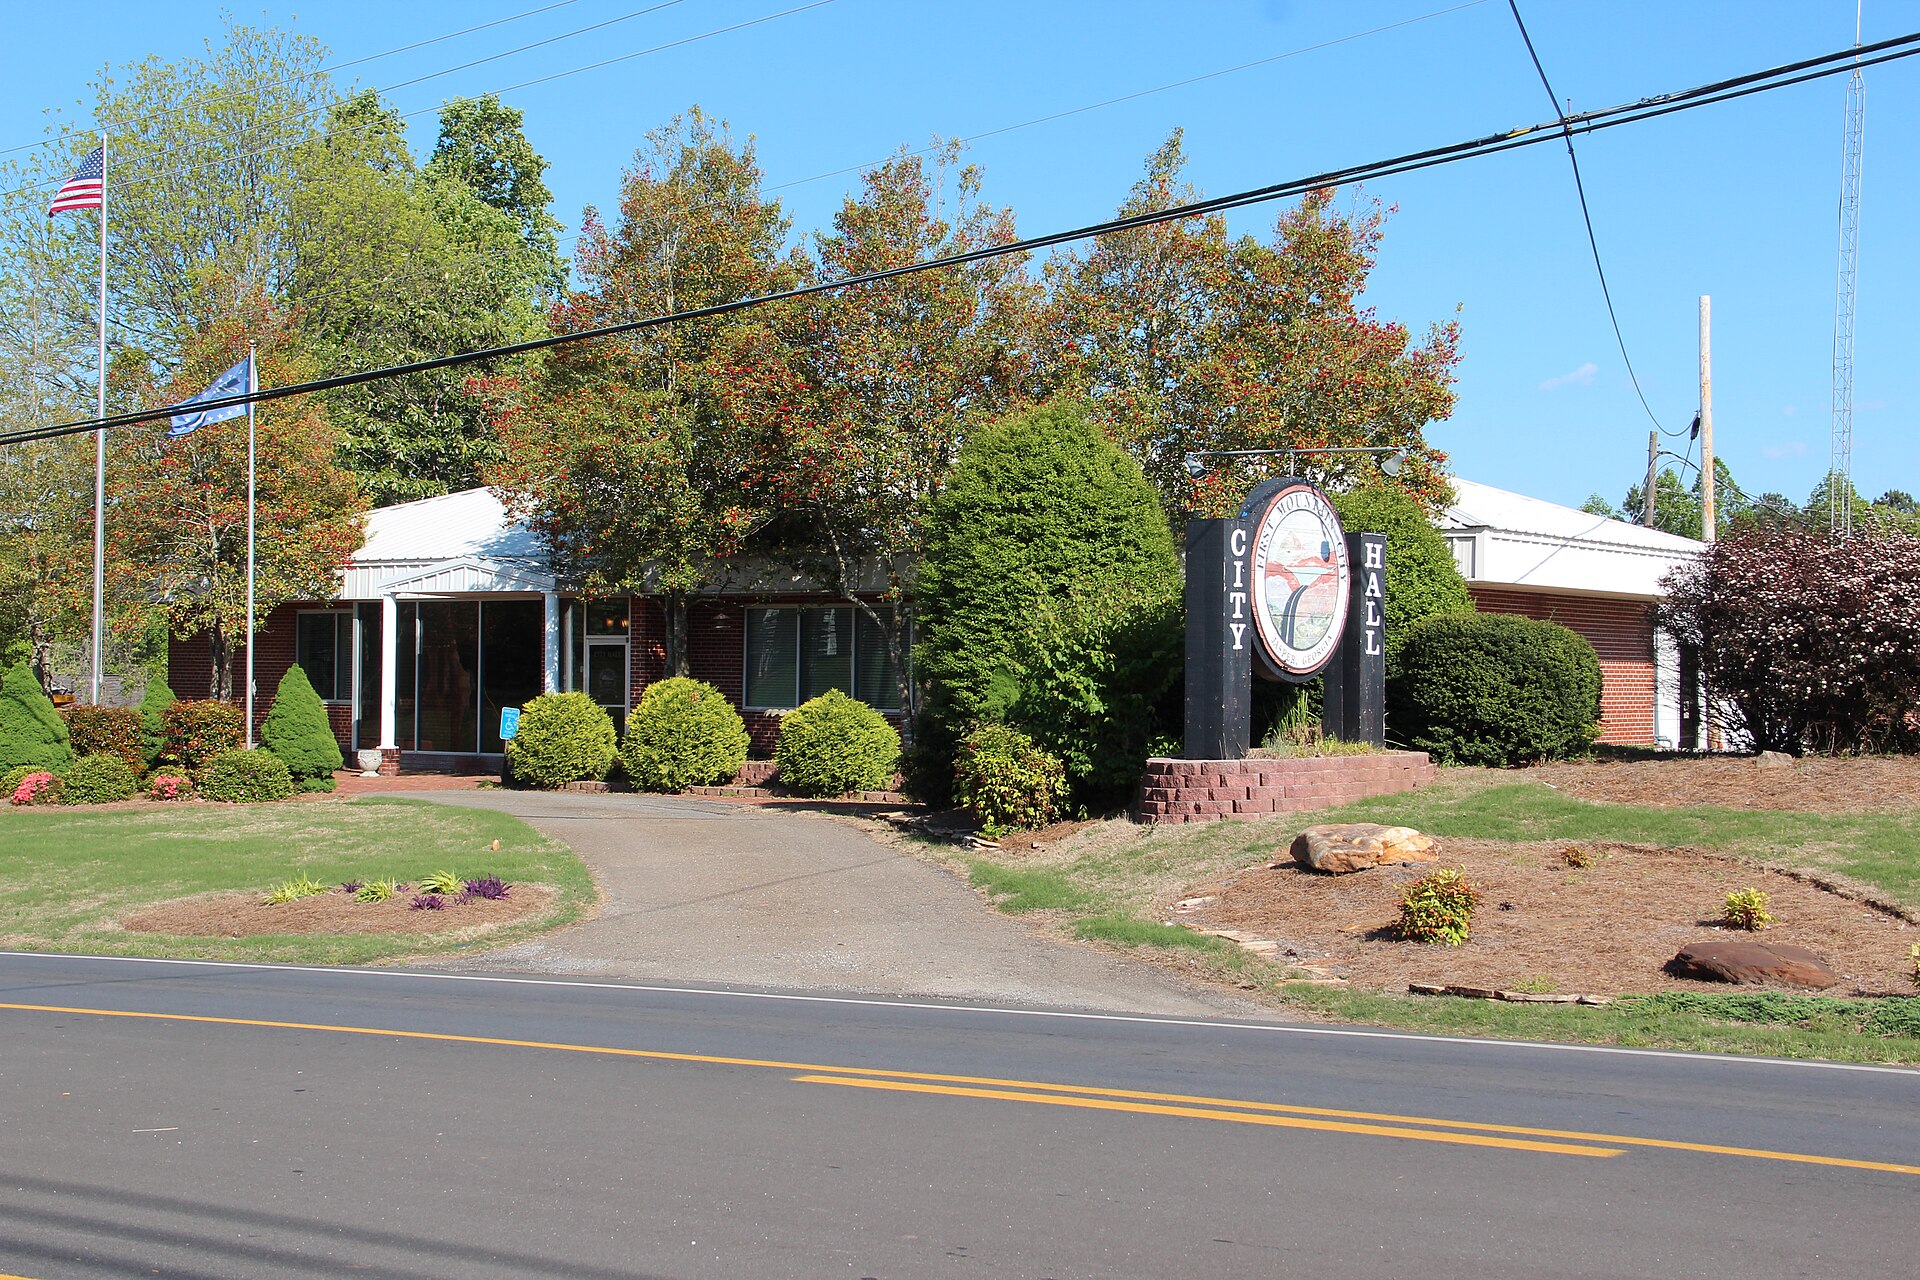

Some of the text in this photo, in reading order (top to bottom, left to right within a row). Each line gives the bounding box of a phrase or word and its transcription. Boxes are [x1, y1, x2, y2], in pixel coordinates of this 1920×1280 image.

[1229, 528, 1247, 650] CITY
[1257, 518, 1275, 570] FIRST
[1337, 541, 1347, 583] CITY
[1364, 543, 1383, 656] HALL
[1302, 634, 1333, 666] GEORGIA
